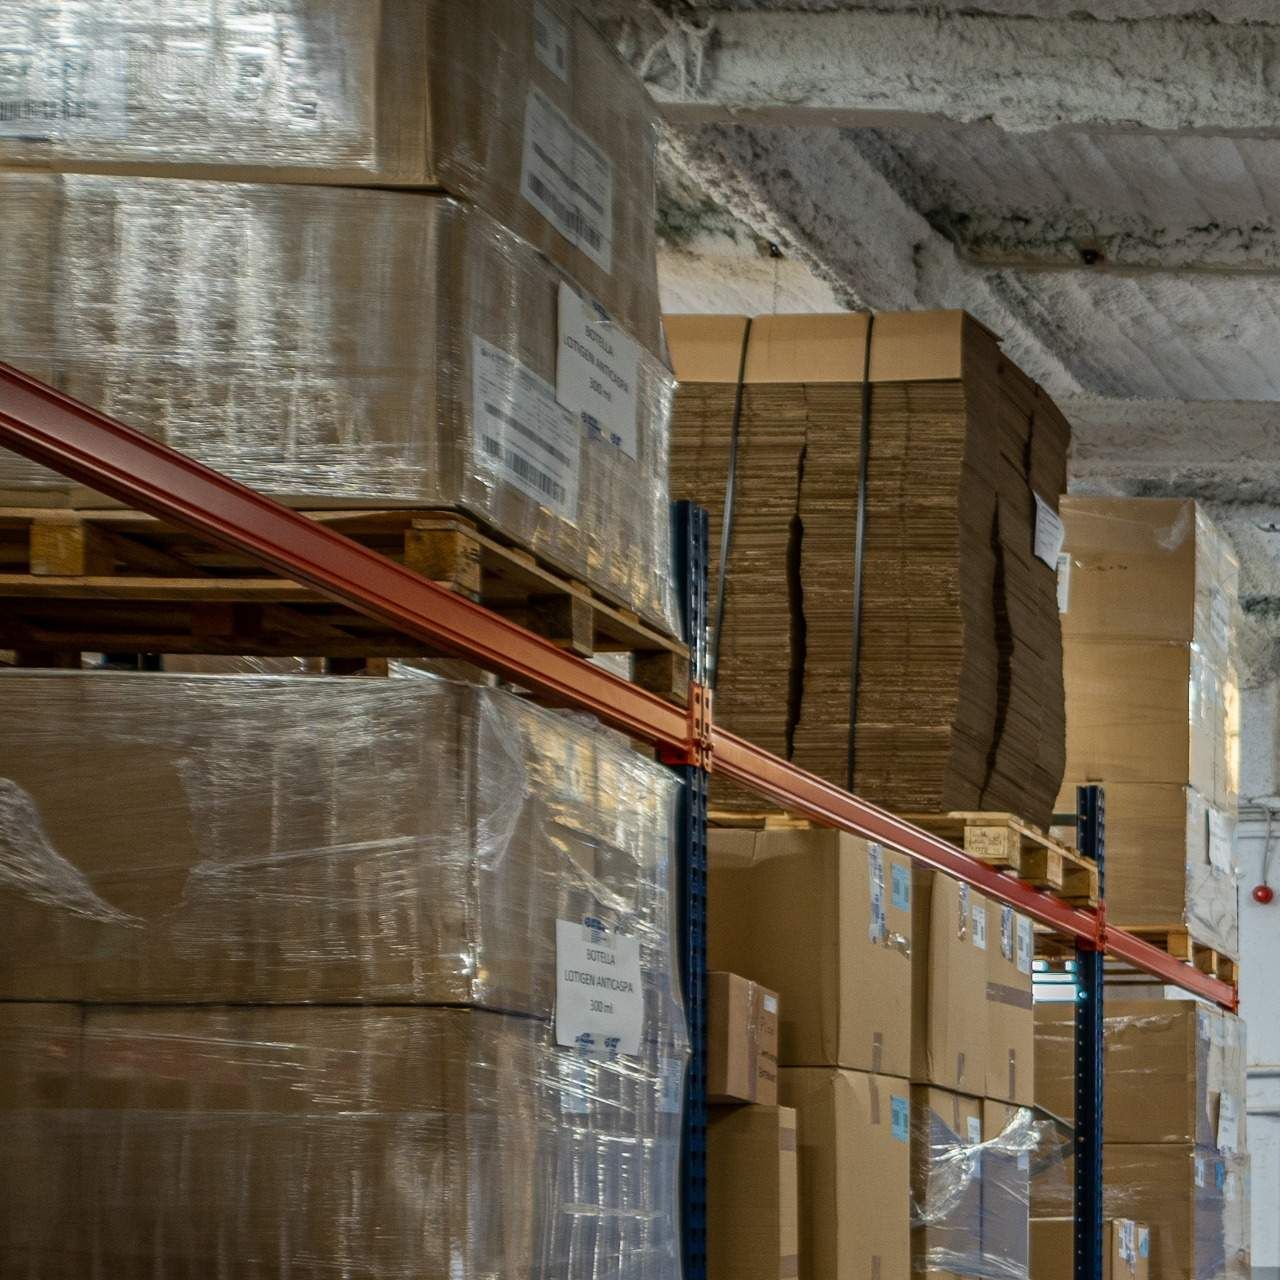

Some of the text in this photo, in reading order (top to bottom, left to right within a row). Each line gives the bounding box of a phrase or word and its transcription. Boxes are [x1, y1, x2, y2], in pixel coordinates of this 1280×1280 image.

[586, 948, 615, 966] BOTELLA
[564, 969, 634, 993] LOTIGEN ANTICASPA
[590, 999, 602, 1013] 300
